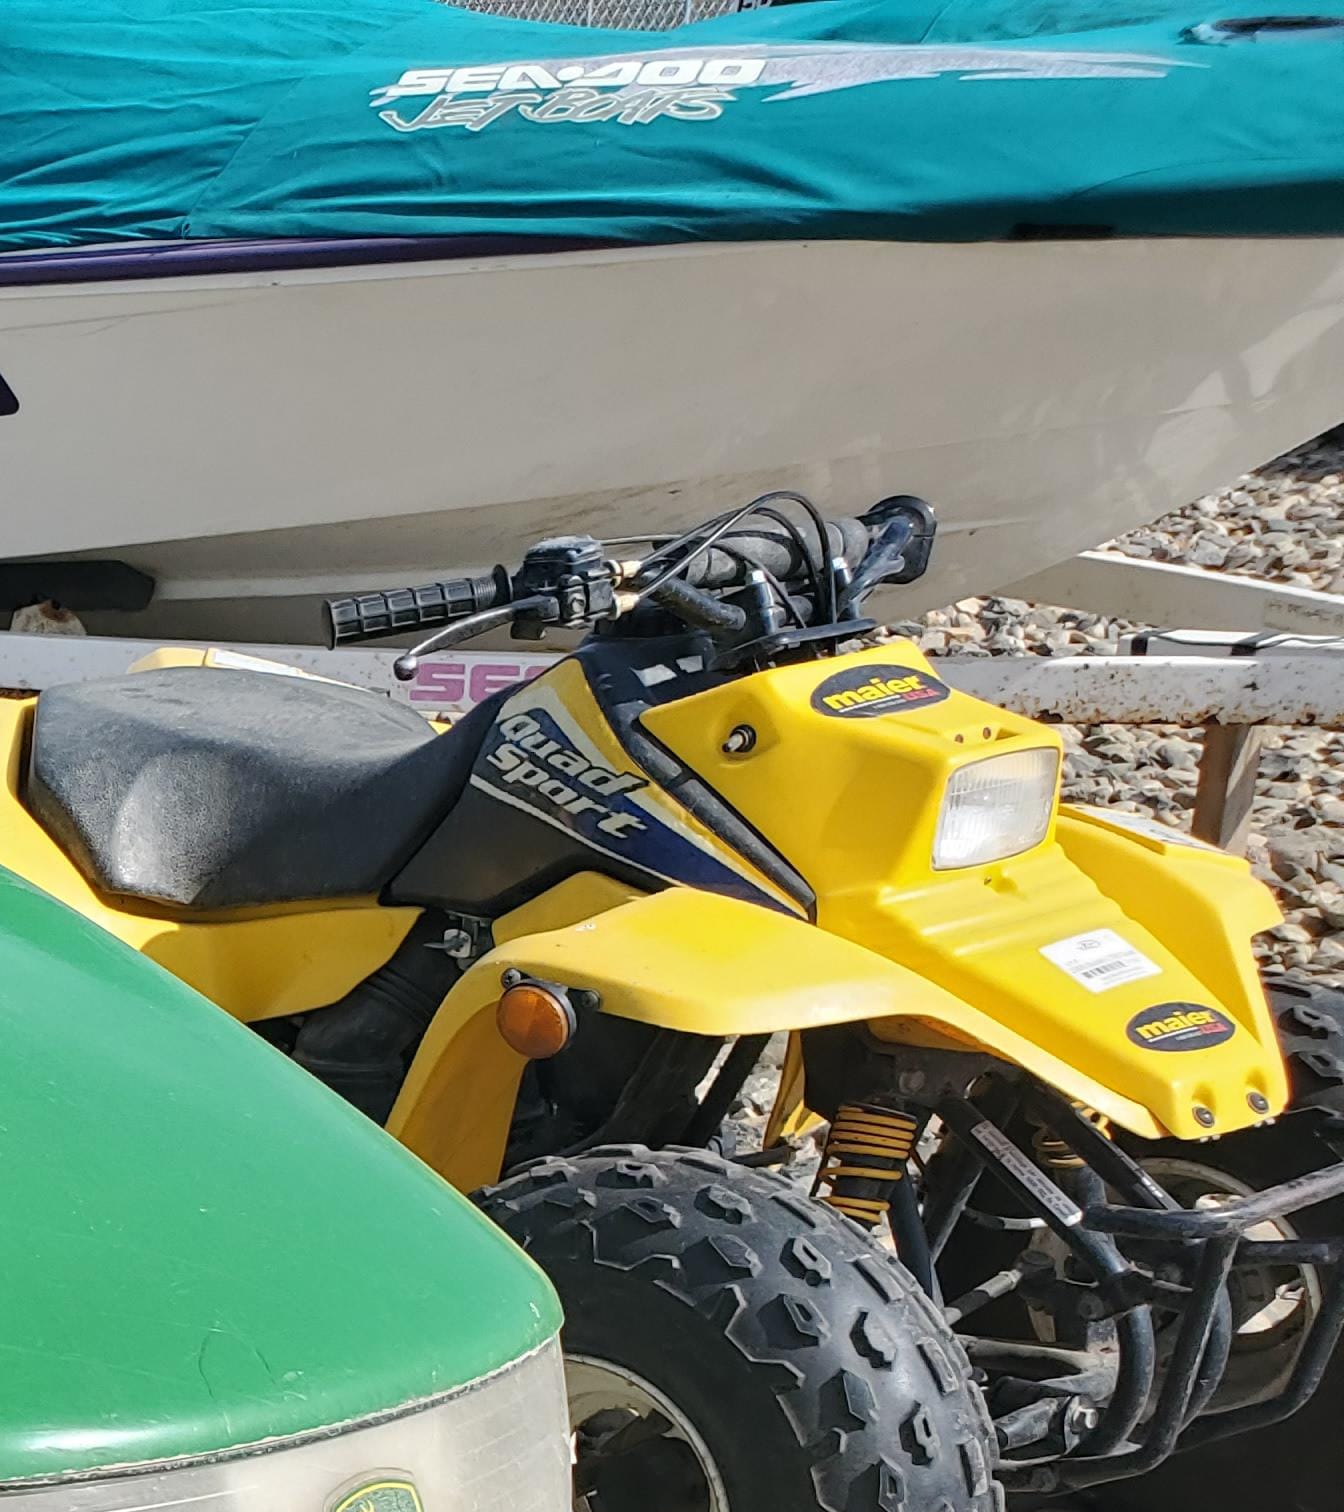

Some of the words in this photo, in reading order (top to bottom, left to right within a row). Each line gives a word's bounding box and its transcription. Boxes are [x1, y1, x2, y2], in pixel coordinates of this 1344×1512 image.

[823, 674, 926, 710] maier
[499, 713, 649, 796] Quad
[1135, 1010, 1217, 1040] maier
